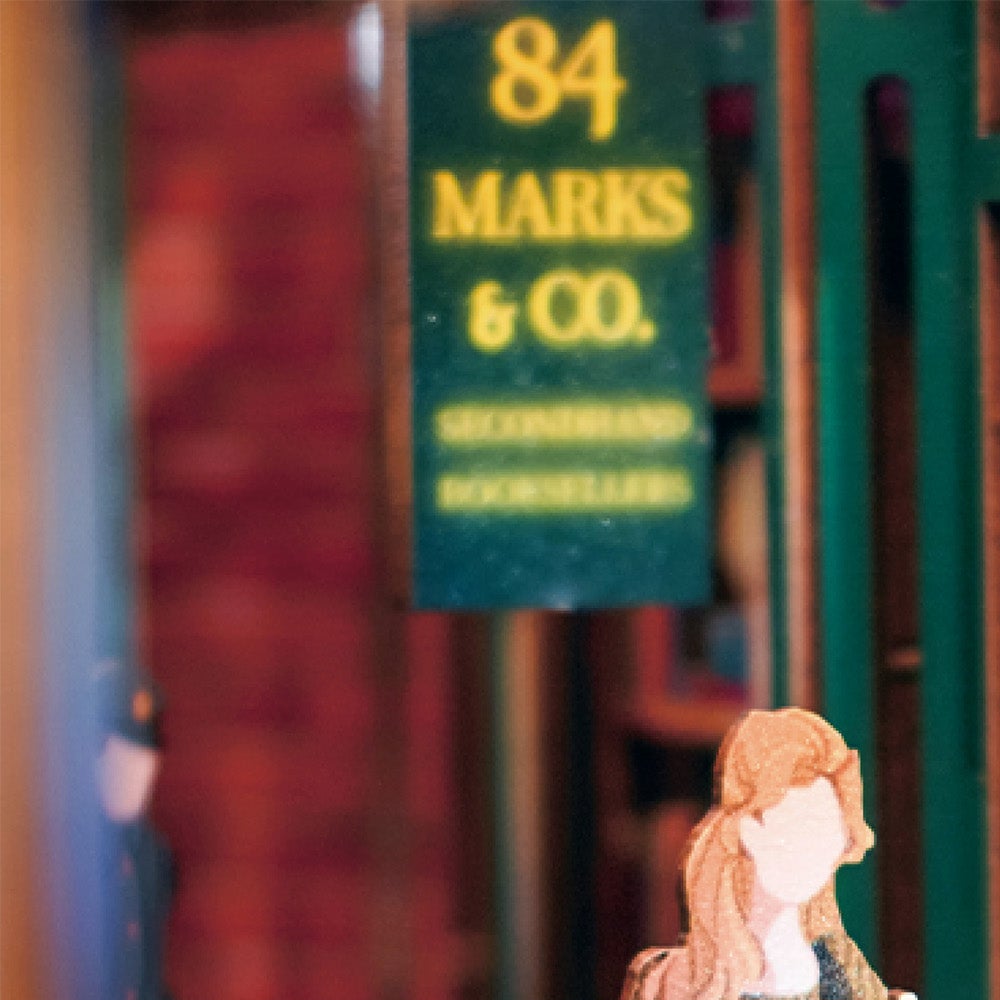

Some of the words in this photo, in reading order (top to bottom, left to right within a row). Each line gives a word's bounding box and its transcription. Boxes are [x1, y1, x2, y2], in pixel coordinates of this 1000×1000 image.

[490, 15, 627, 142] 84
[430, 168, 692, 243] MARKS
[467, 279, 517, 353] &
[526, 267, 657, 346] CO.
